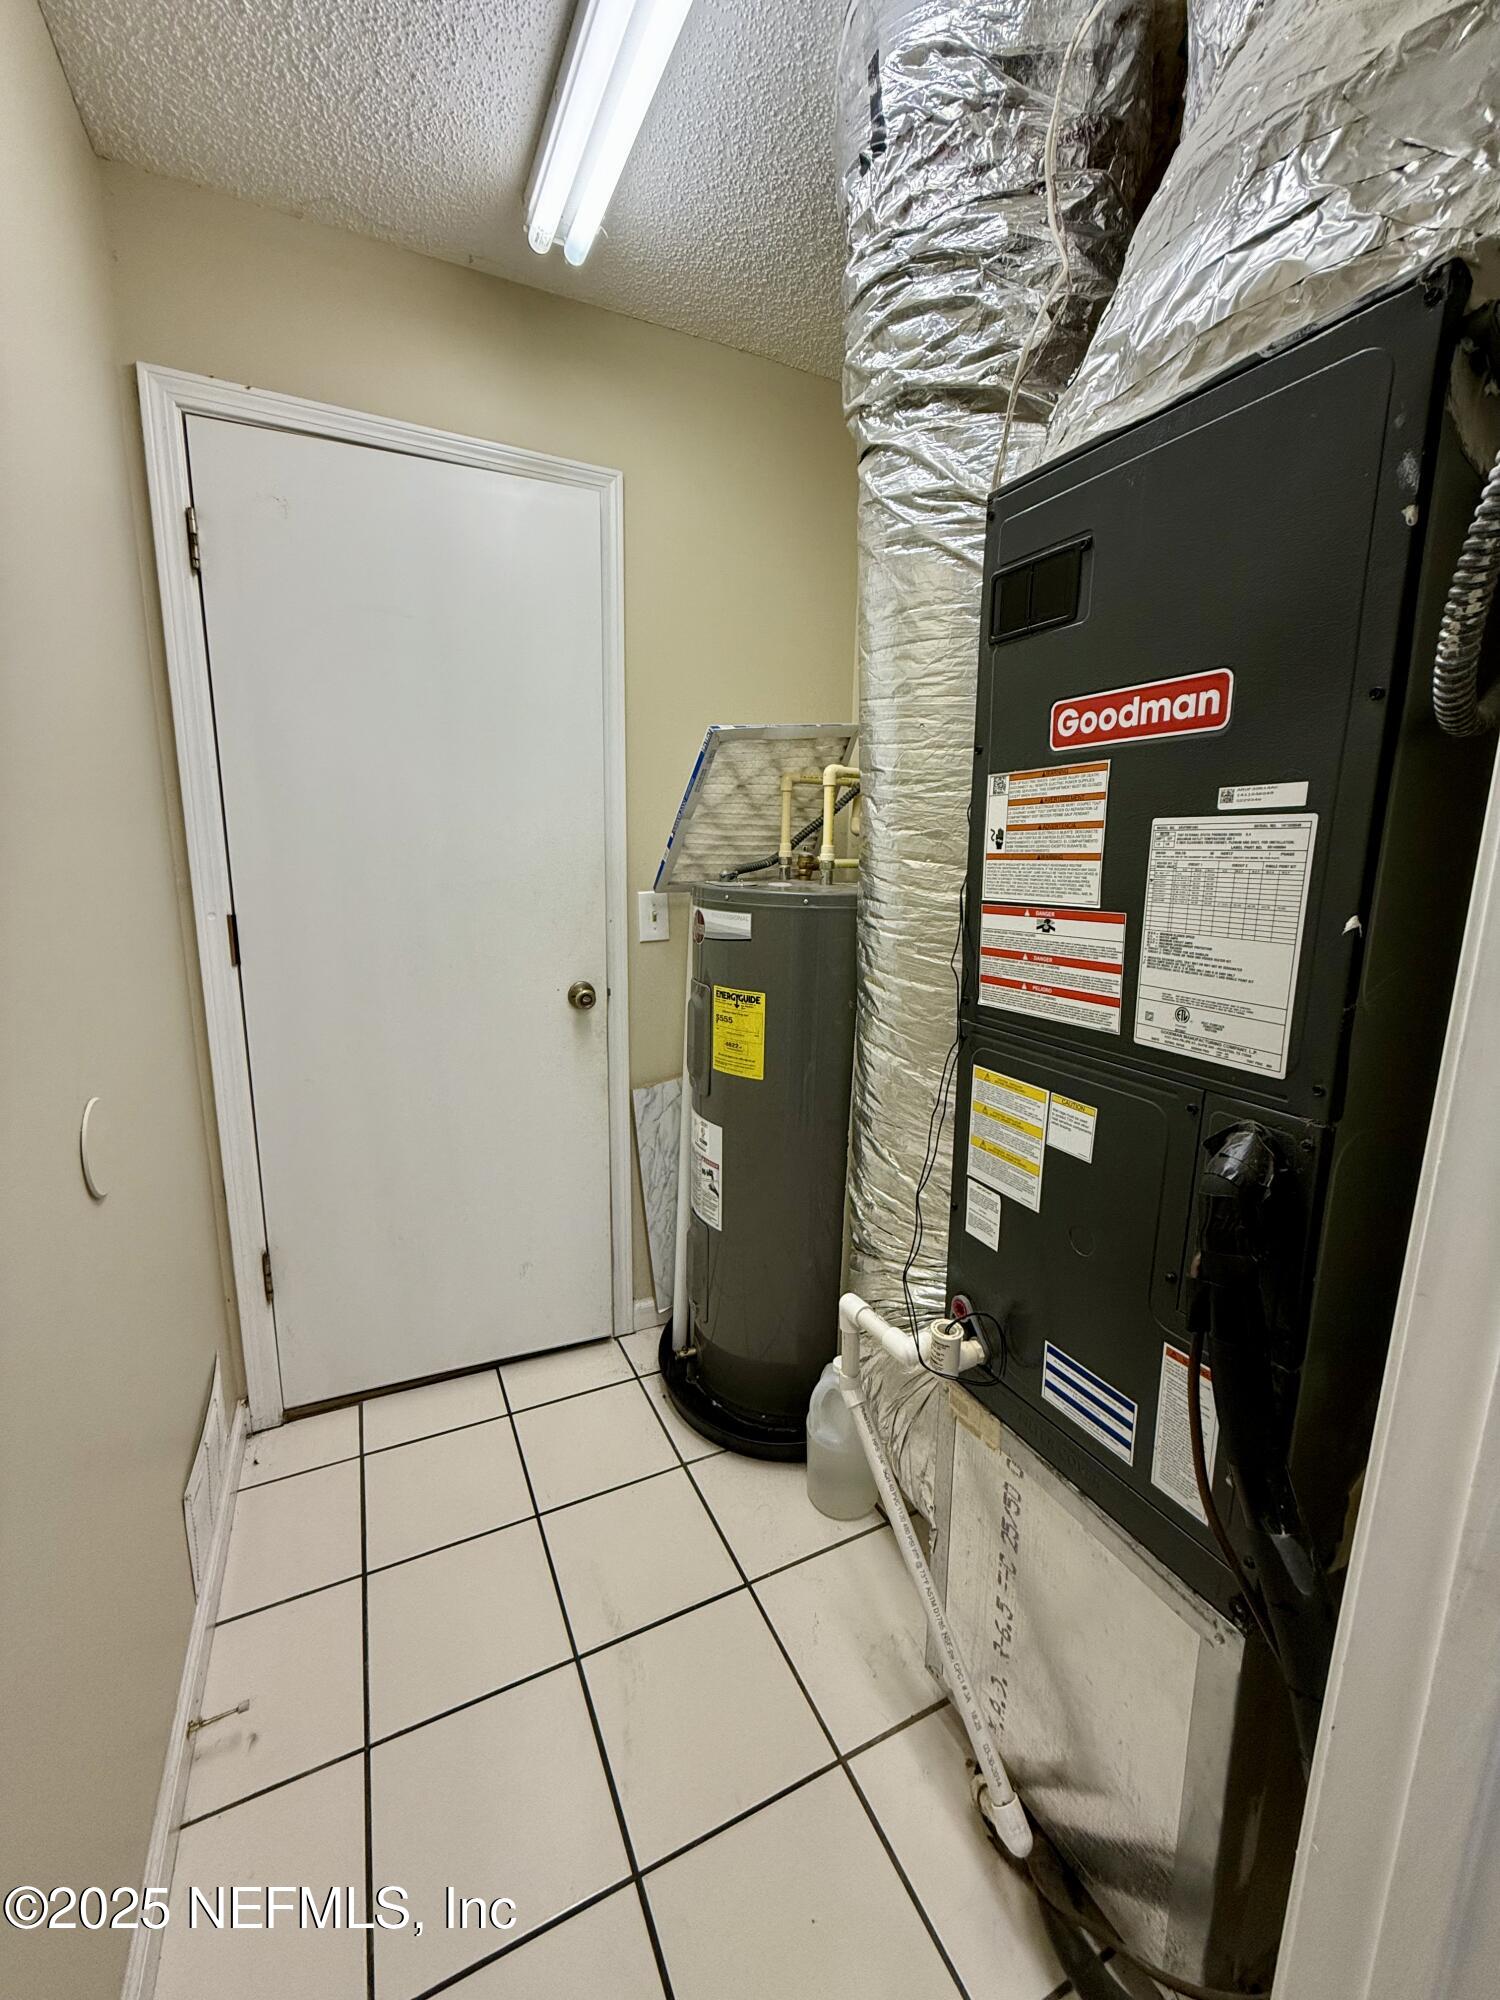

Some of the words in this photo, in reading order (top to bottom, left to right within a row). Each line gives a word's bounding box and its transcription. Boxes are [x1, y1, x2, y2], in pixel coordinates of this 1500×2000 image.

[1057, 688, 1221, 738] Goodman
[1035, 909, 1056, 917] DANGER
[1033, 955, 1053, 963] DANGER
[1032, 985, 1053, 994] PELIGRO
[1061, 1099, 1086, 1112] CAUTION
[925, 1586, 938, 1608] ASTM
